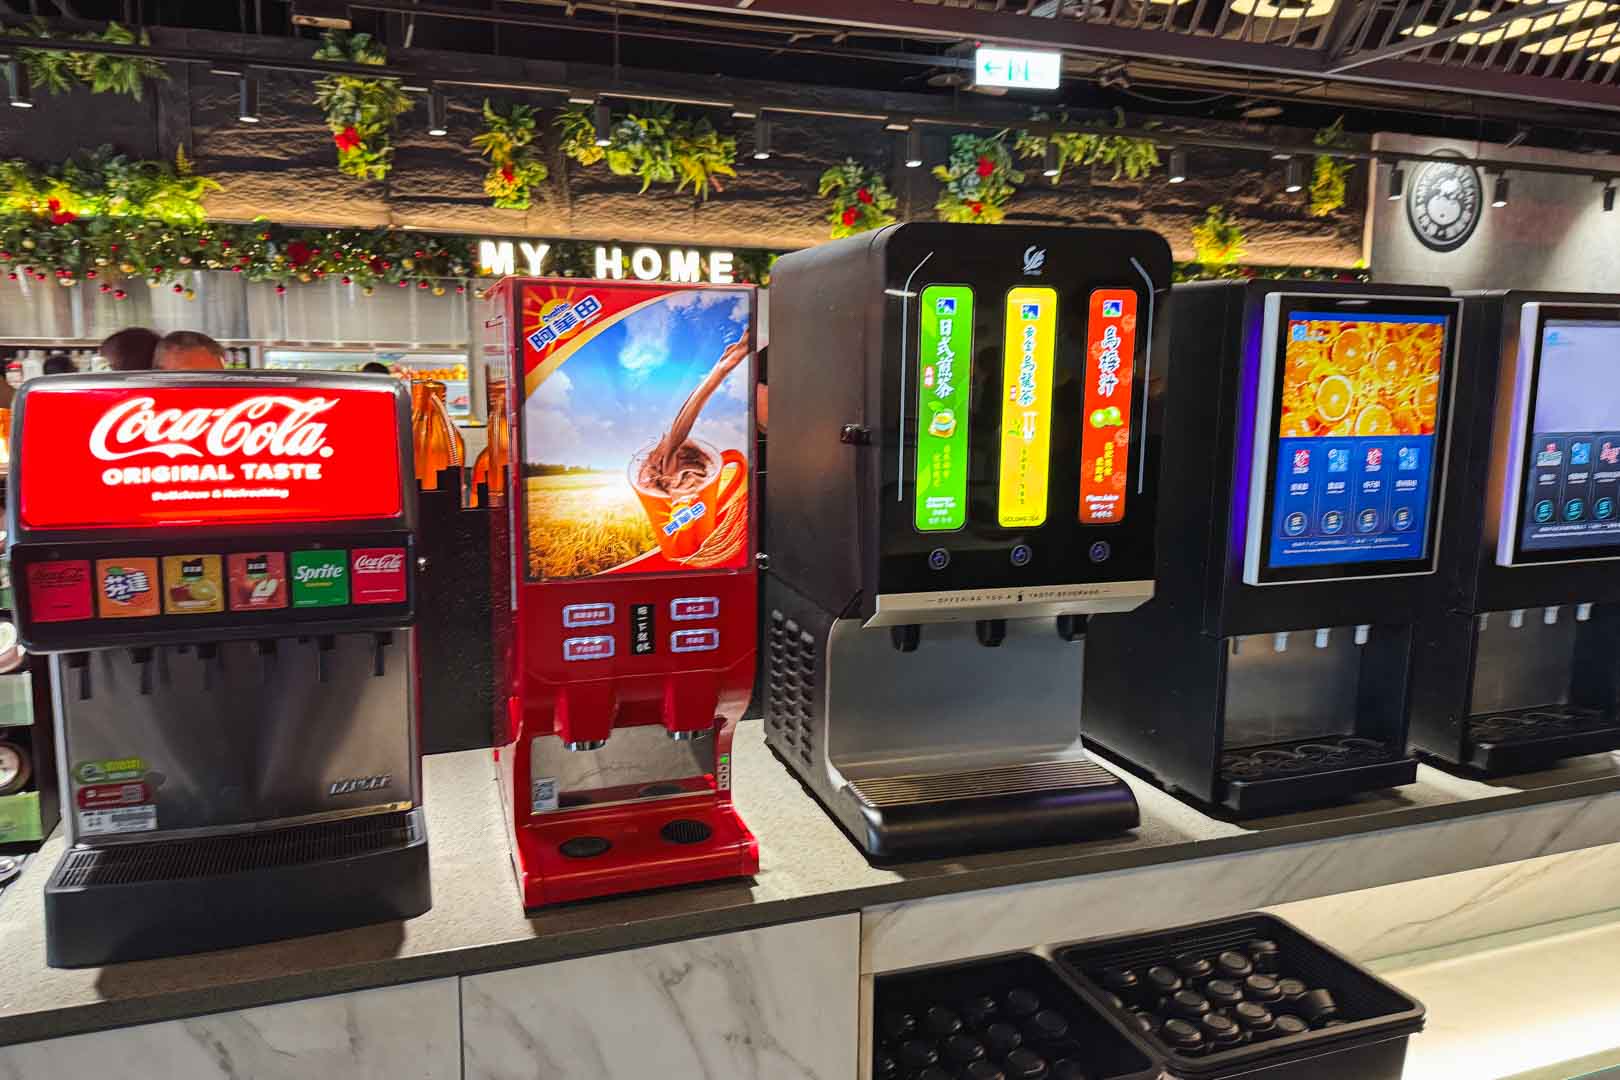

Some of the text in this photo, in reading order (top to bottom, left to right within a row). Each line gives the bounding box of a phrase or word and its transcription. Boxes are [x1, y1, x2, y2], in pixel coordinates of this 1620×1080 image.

[480, 240, 734, 284] MY HOME
[529, 295, 600, 352] 阿華田
[89, 396, 340, 460] Coca-Cola
[102, 462, 322, 486] ORIGINAL TASTE
[294, 563, 345, 582] Sprite
